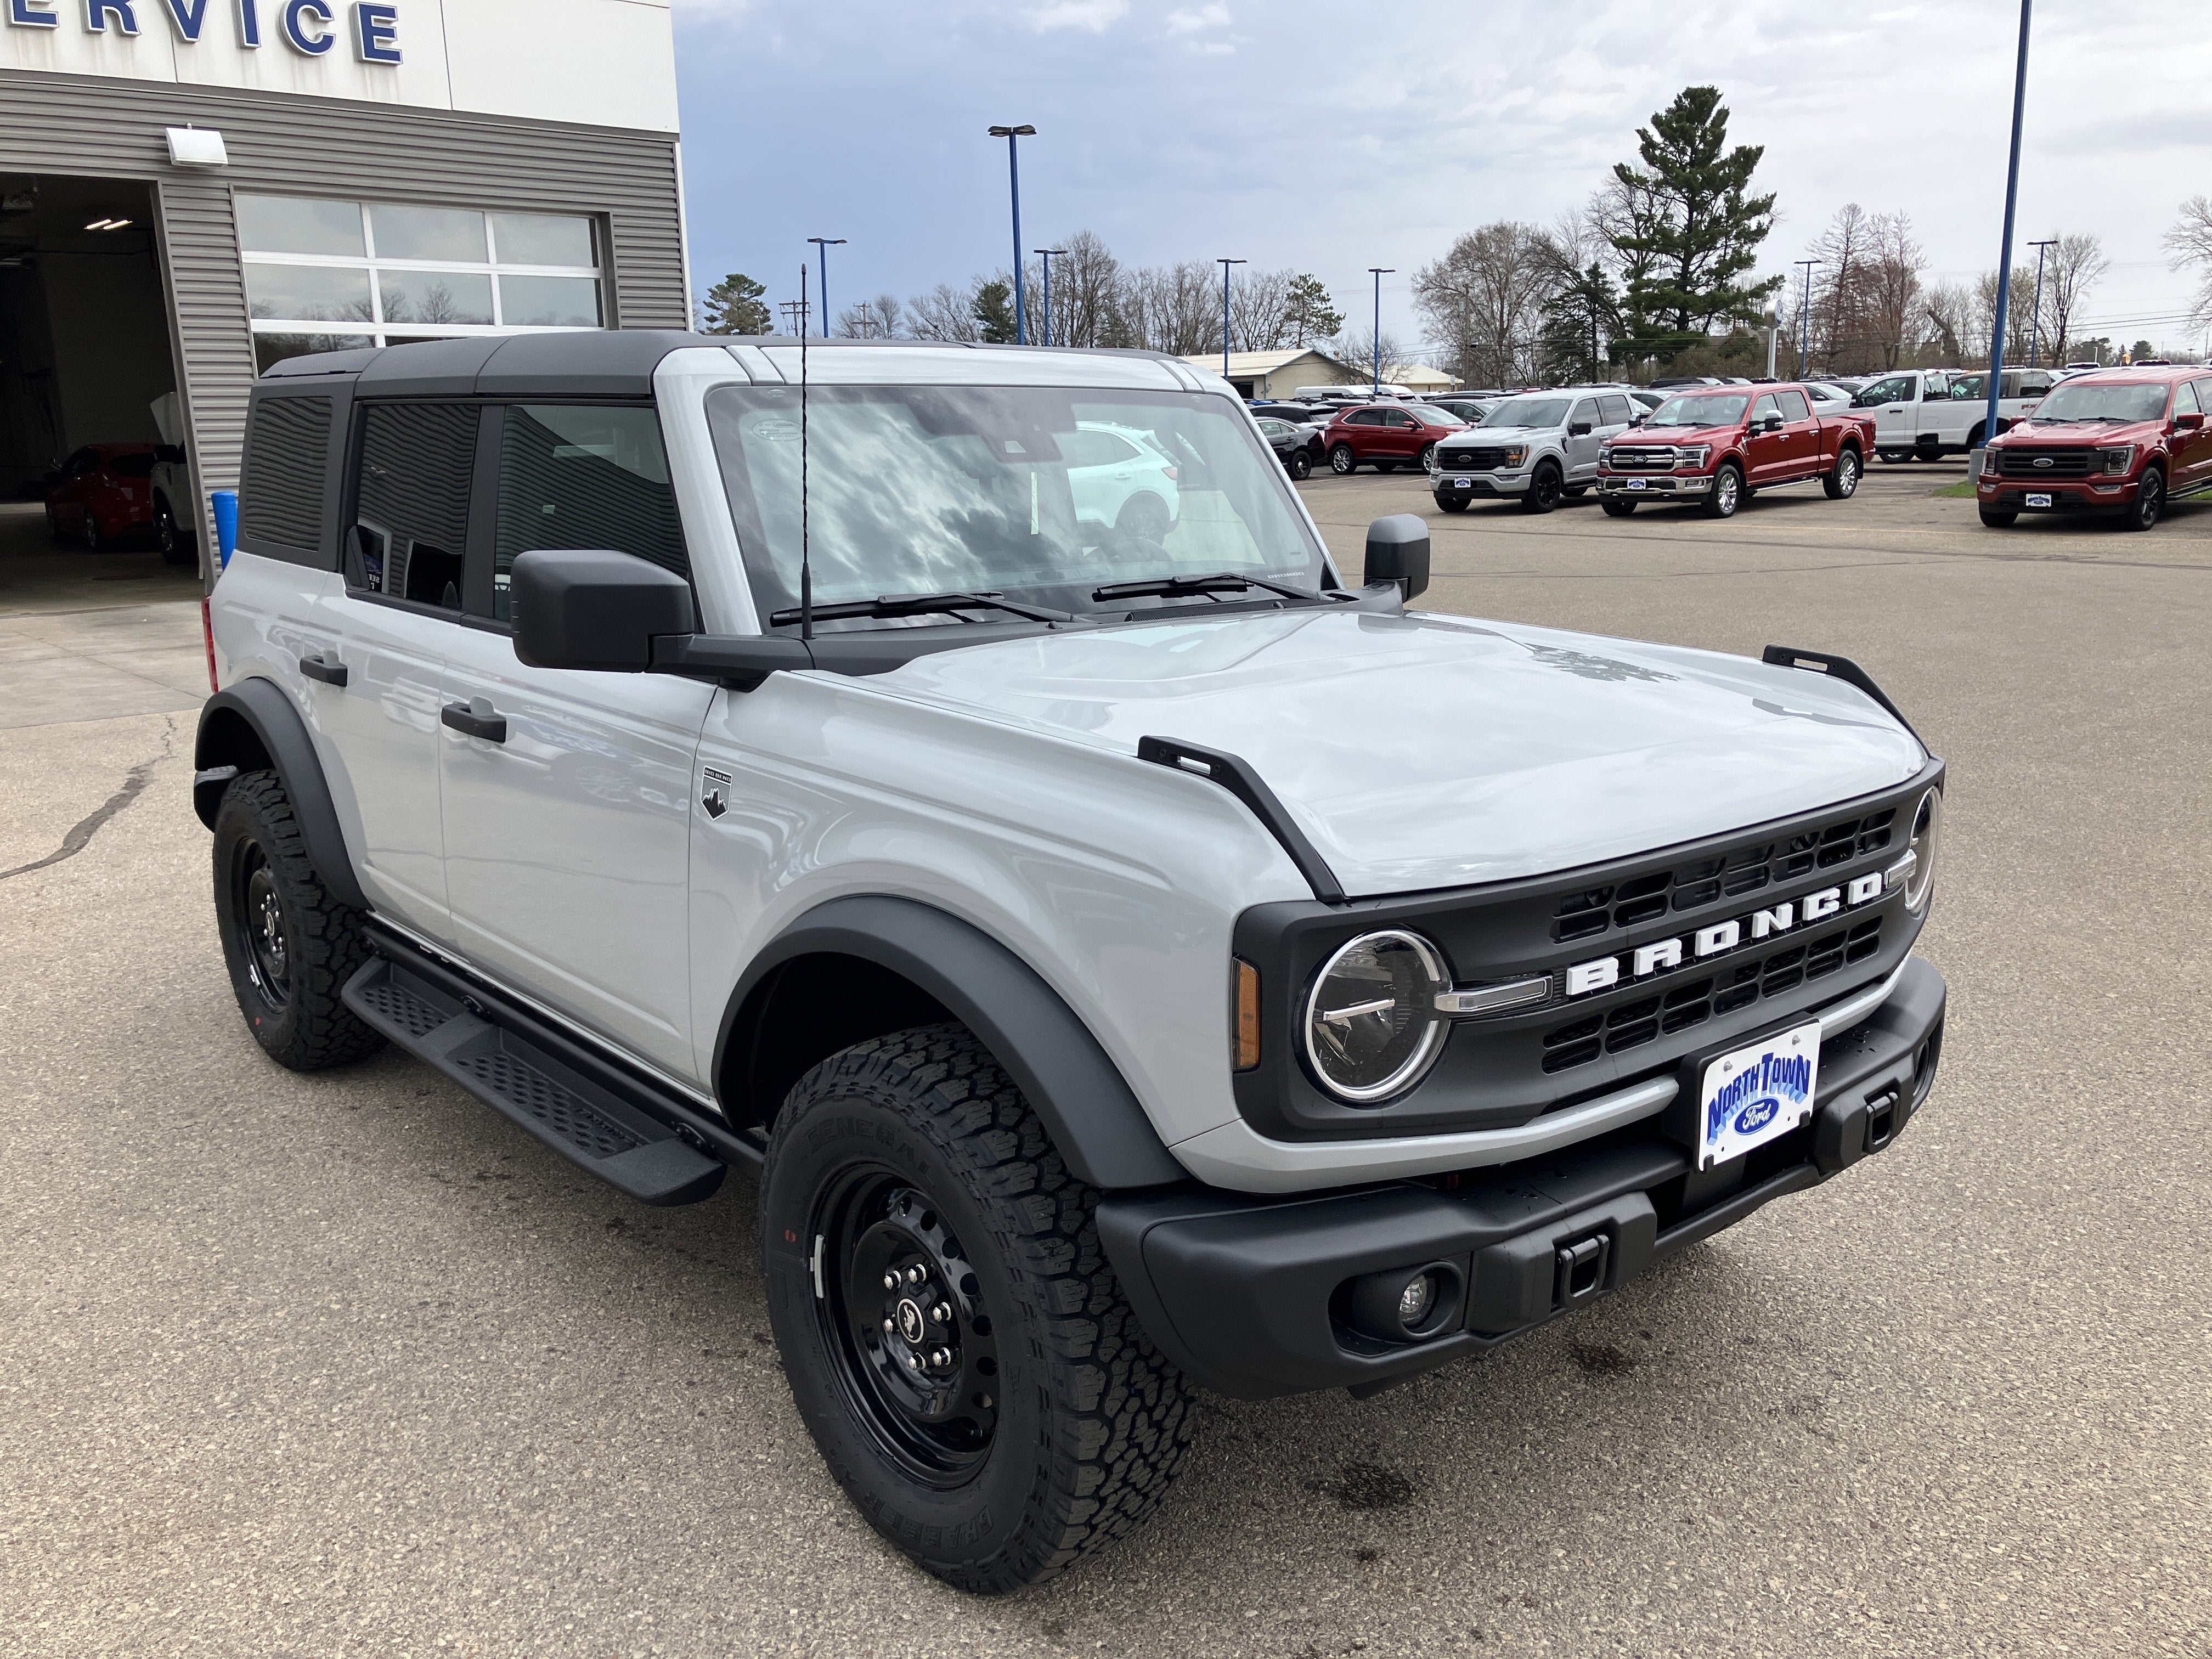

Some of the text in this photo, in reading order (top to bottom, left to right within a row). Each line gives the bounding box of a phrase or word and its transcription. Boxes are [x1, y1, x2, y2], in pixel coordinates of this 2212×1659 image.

[1267, 571, 1305, 579] BRONCO
[715, 772, 731, 782] BEND
[1565, 872, 1882, 996] BRONCO
[1741, 1101, 1773, 1131] Ford
